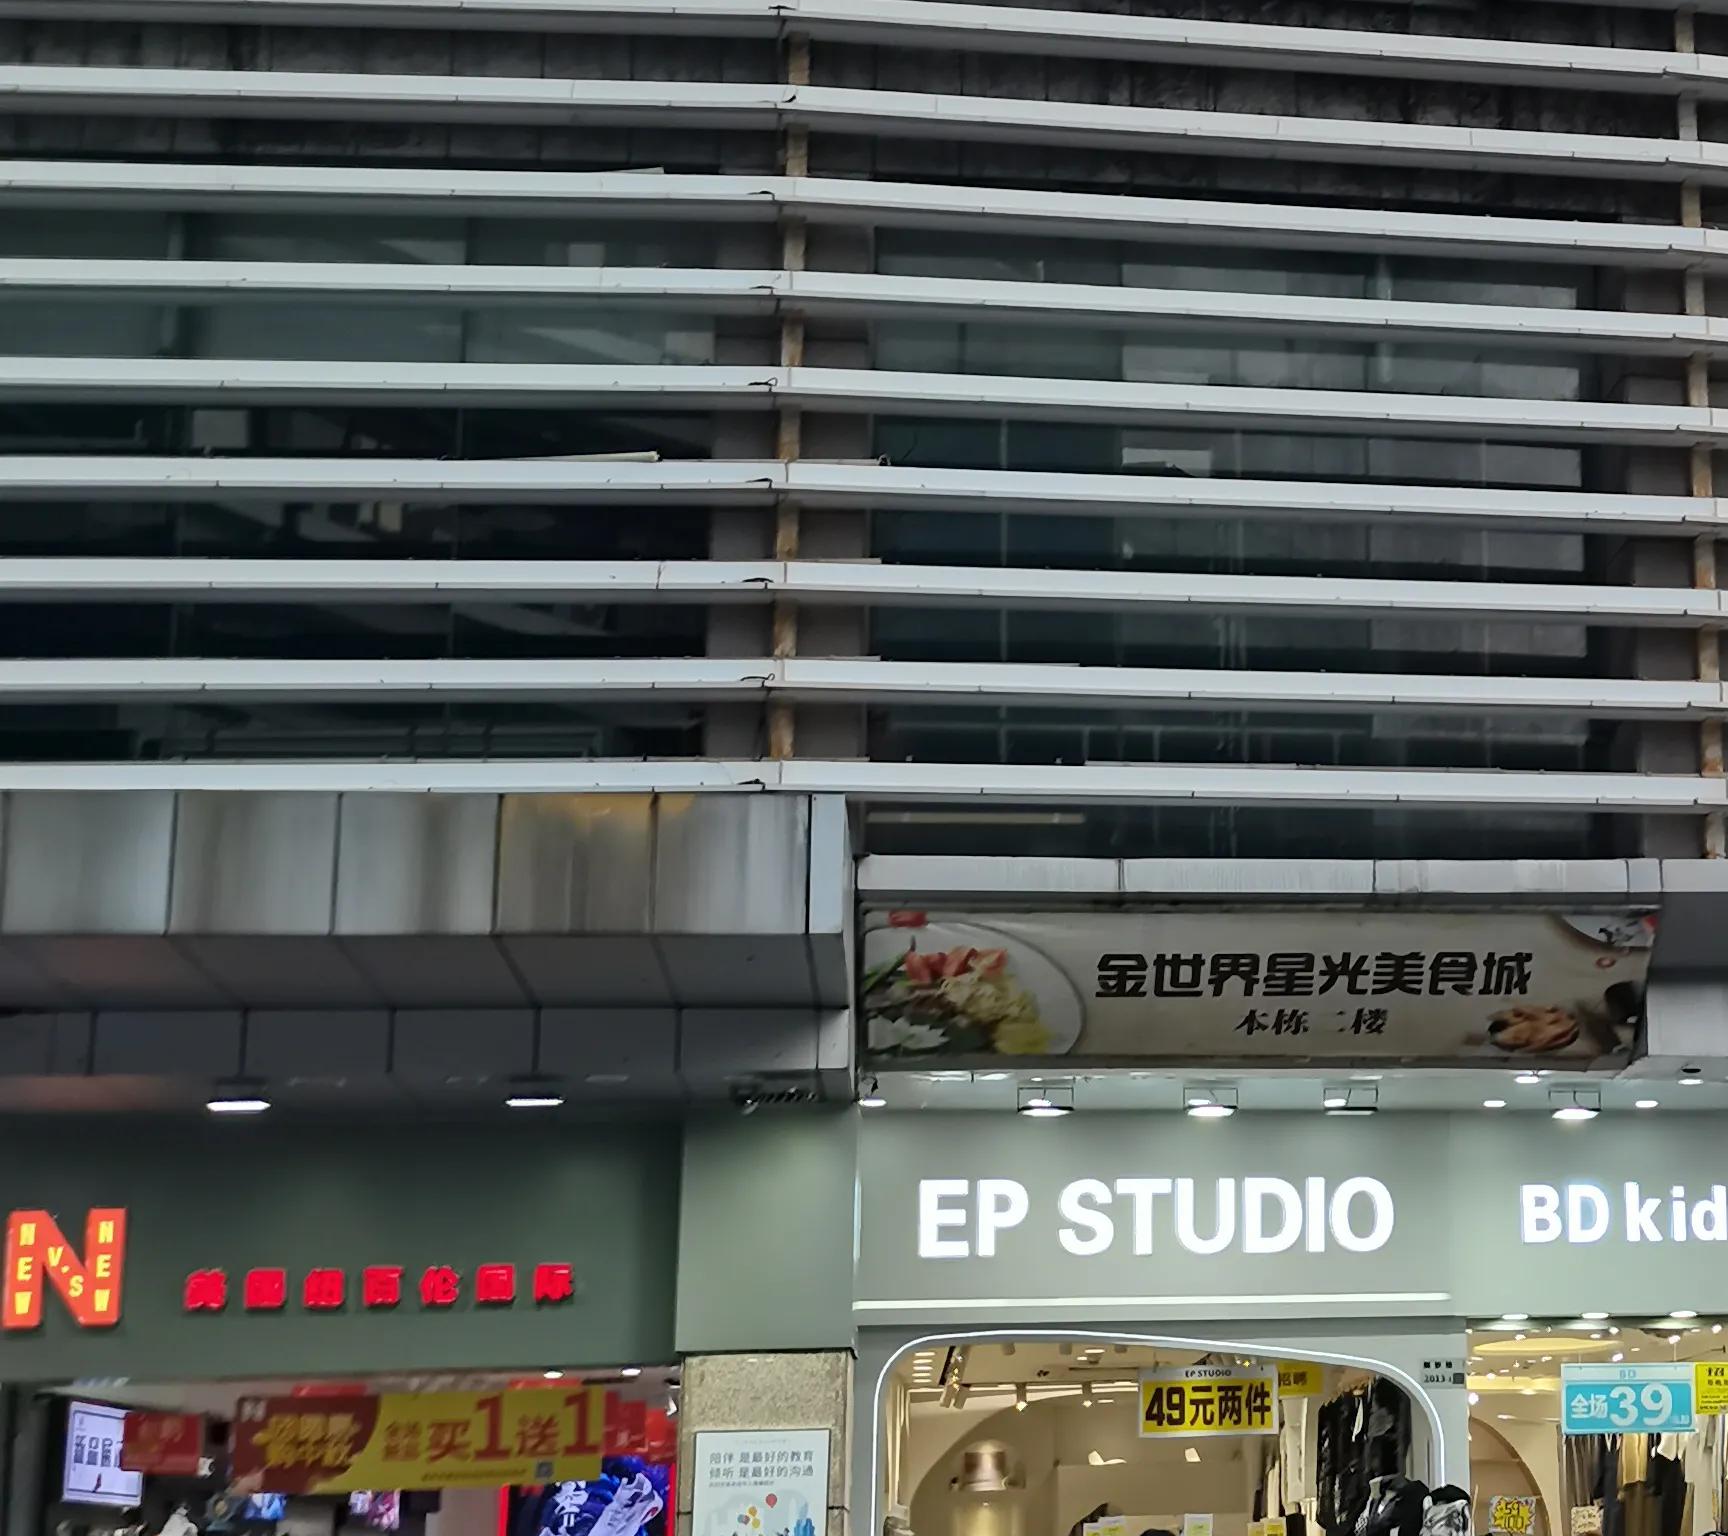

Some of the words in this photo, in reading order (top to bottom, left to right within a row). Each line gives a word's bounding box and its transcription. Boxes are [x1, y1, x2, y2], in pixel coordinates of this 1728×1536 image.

[1095, 951, 1535, 999] 金世界星光美食城
[1234, 1007, 1389, 1038] 本栋二楼
[918, 1177, 1029, 1258] EP
[1057, 1175, 1395, 1256] STUDIO
[1520, 1183, 1610, 1244] BD
[1145, 1381, 1272, 1427] 49元两件
